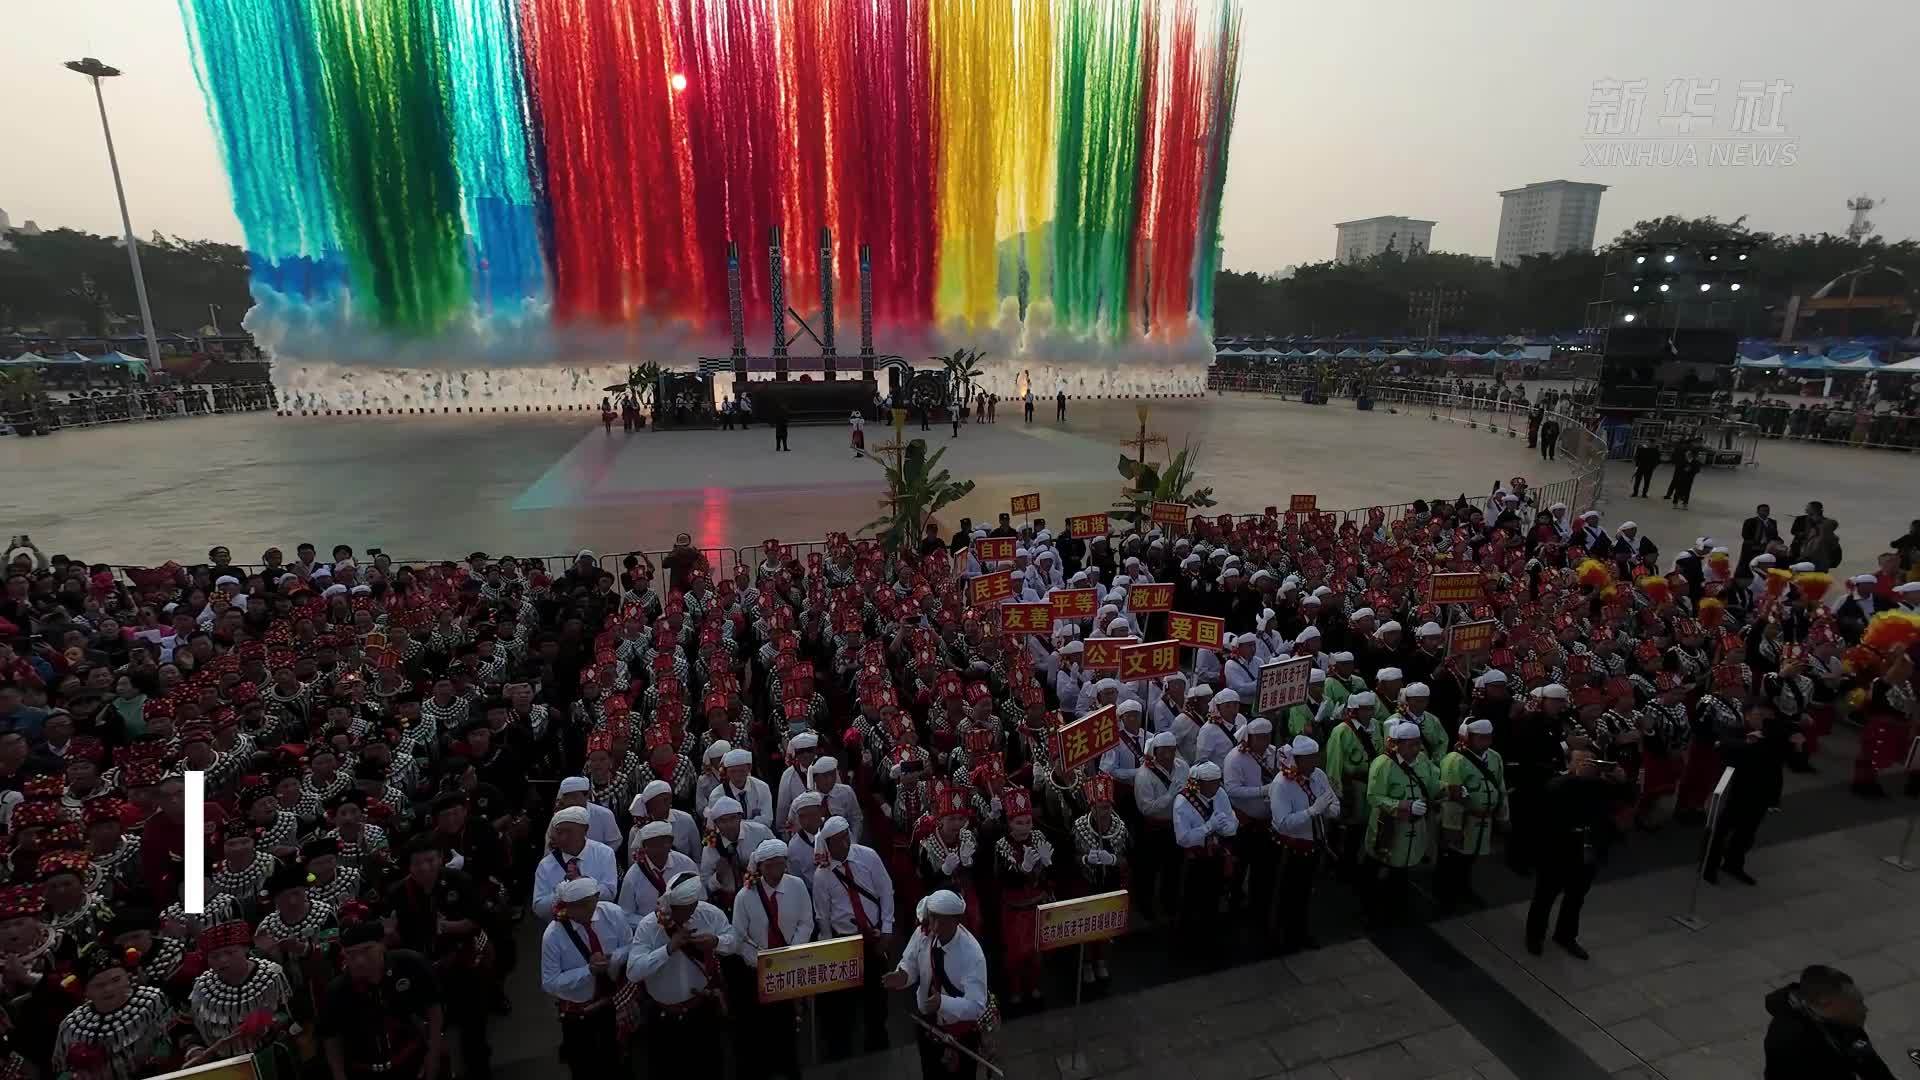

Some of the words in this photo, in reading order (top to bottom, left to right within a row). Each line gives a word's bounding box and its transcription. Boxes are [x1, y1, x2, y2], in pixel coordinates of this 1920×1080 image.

[1013, 497, 1040, 514] 诚信
[1072, 516, 1106, 534] 和谐
[980, 542, 1014, 559] 自由
[974, 577, 1011, 600] 民主
[1131, 588, 1170, 608] 敬业
[1052, 591, 1094, 615] 平等
[1005, 606, 1050, 629] 友善
[1170, 616, 1219, 646] 爱国
[1126, 646, 1175, 675] 文明
[1066, 715, 1115, 762] 法治
